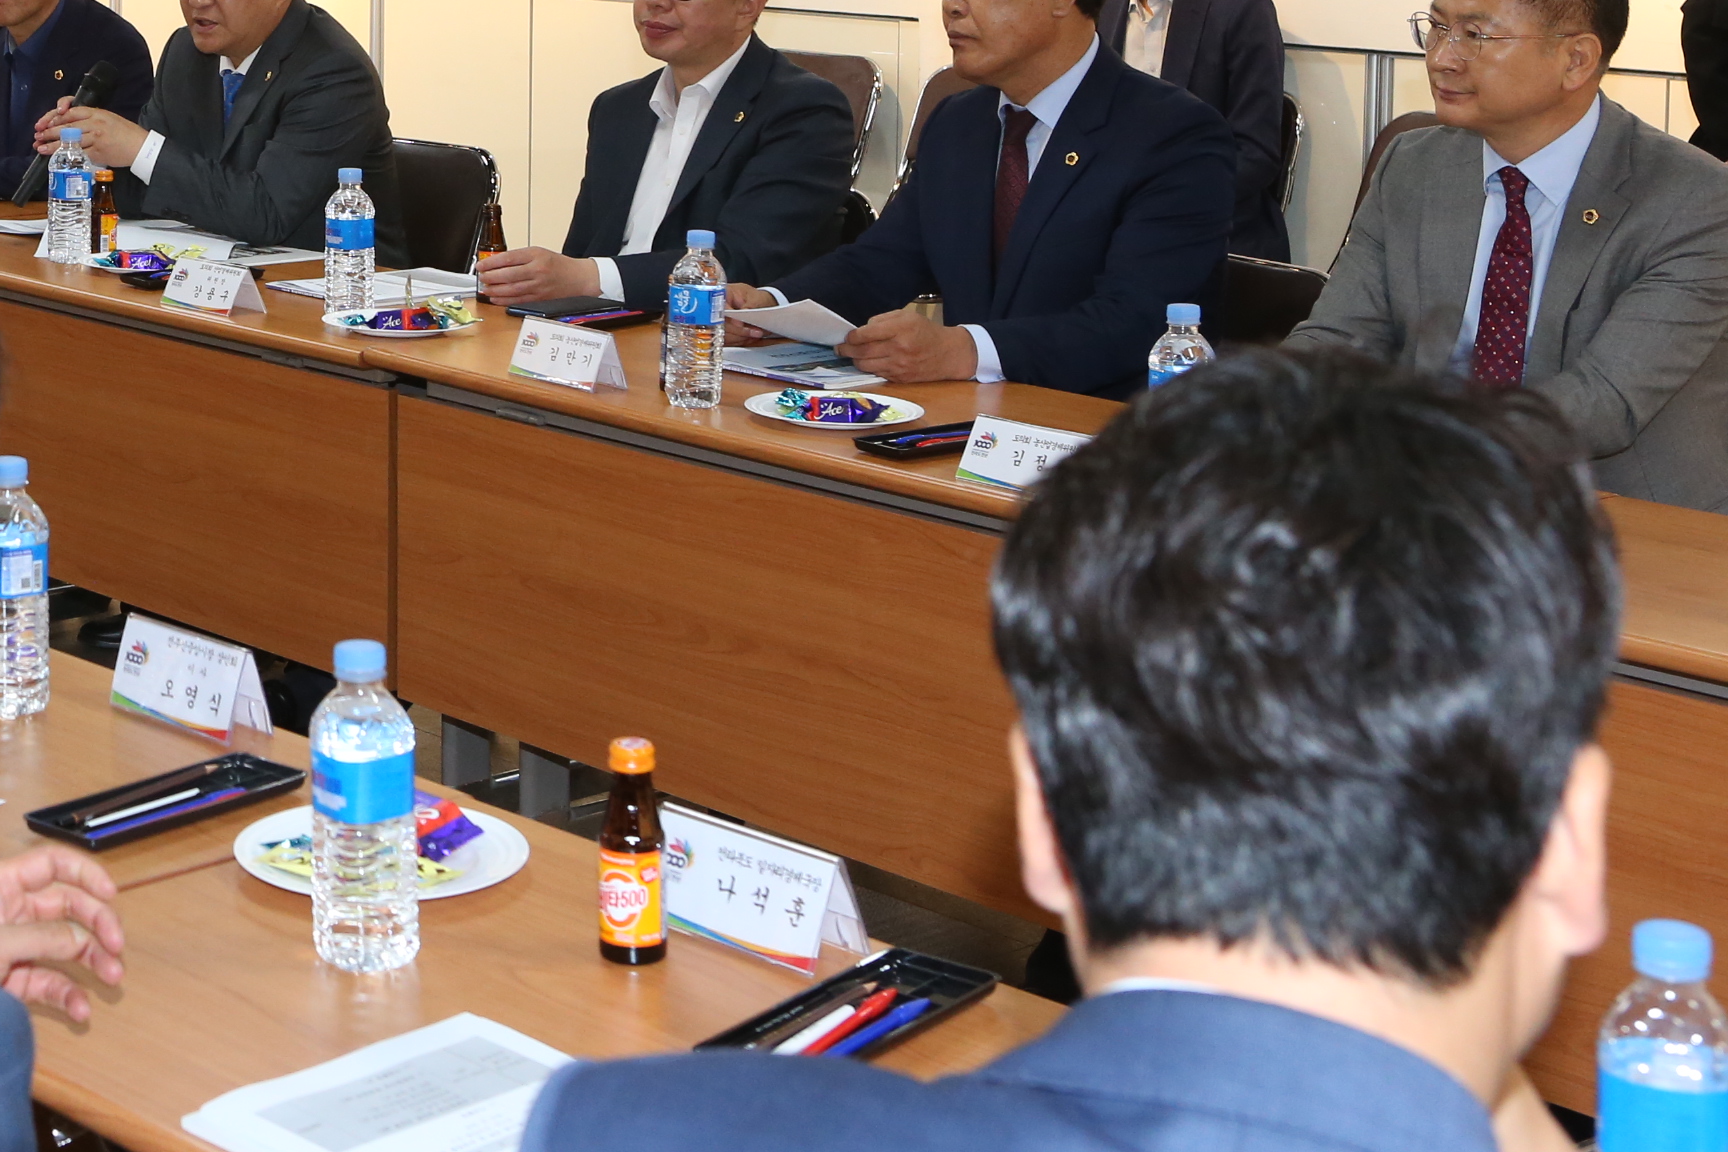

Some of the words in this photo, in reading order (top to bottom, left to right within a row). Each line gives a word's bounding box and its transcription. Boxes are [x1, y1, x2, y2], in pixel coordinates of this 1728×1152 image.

[815, 404, 845, 420] Ace
[1033, 437, 1078, 455] 농산업경제위원
[717, 875, 806, 928] 나석훈
